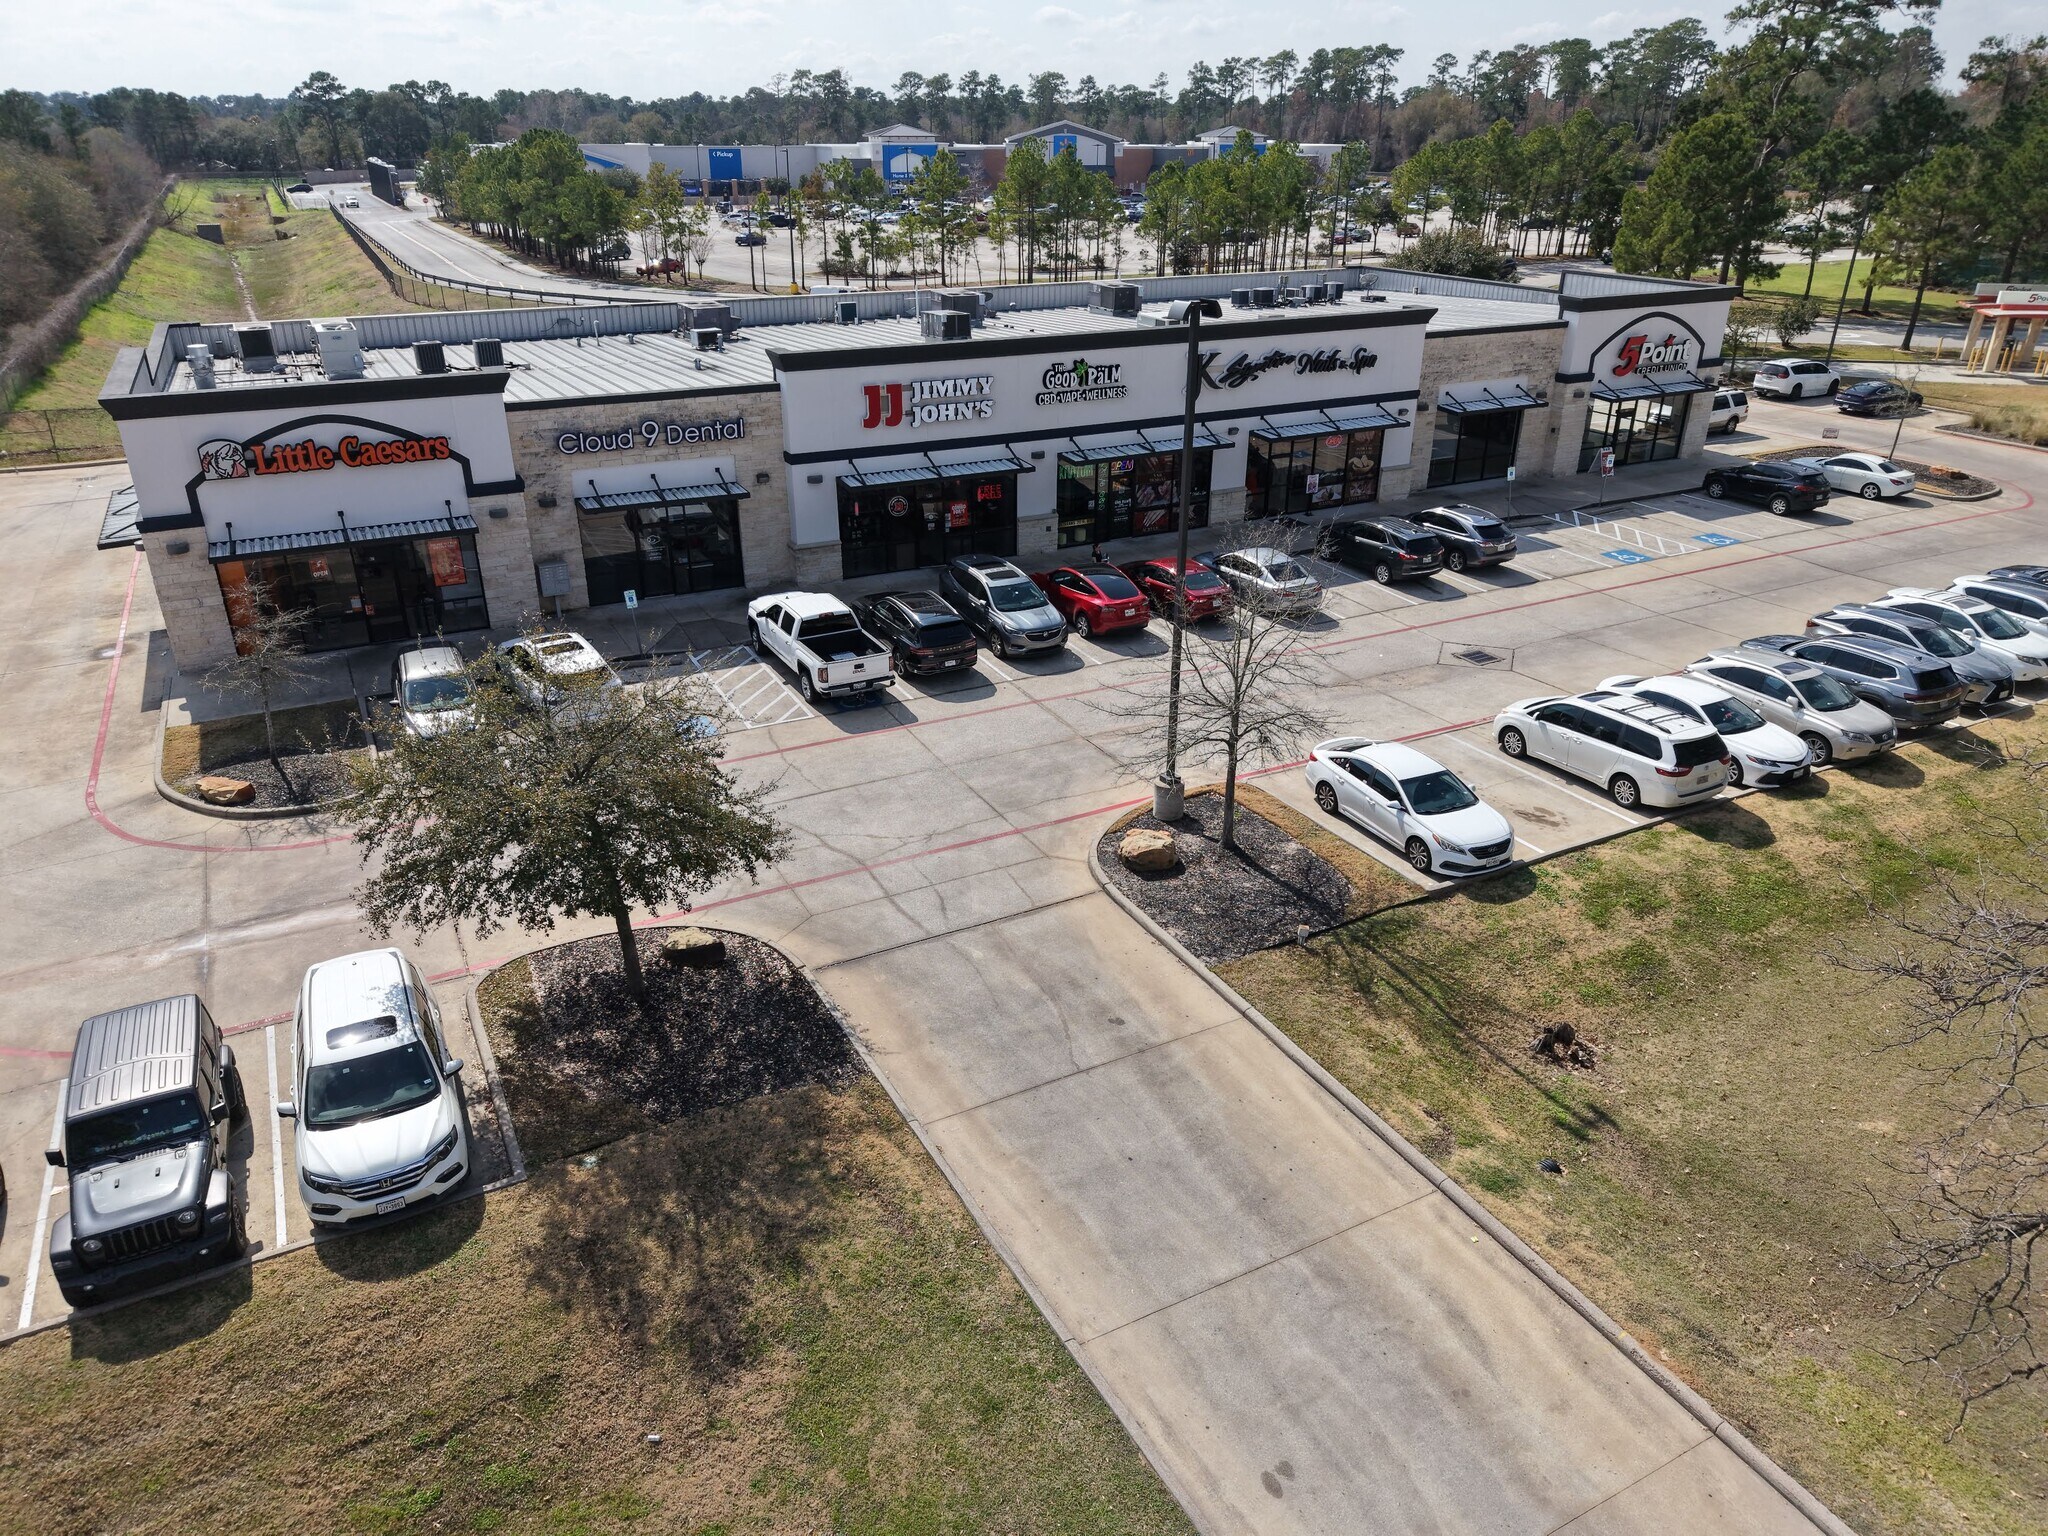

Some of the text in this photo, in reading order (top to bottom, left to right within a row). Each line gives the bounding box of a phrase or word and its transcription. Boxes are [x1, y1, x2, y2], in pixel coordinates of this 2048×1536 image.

[1053, 364, 1066, 373] THE
[1296, 349, 1341, 375] Nails
[1349, 347, 1378, 375] Spa
[1636, 363, 1688, 375] CREDIT UNION
[911, 376, 994, 404] JIMMY
[862, 384, 903, 429] JJ
[911, 399, 994, 428] JOHN'S
[558, 418, 745, 454] Cloud 9 Dental
[251, 436, 450, 475] Little Caesars
[1111, 459, 1134, 471] OPEN
[313, 570, 328, 578] OPEN
